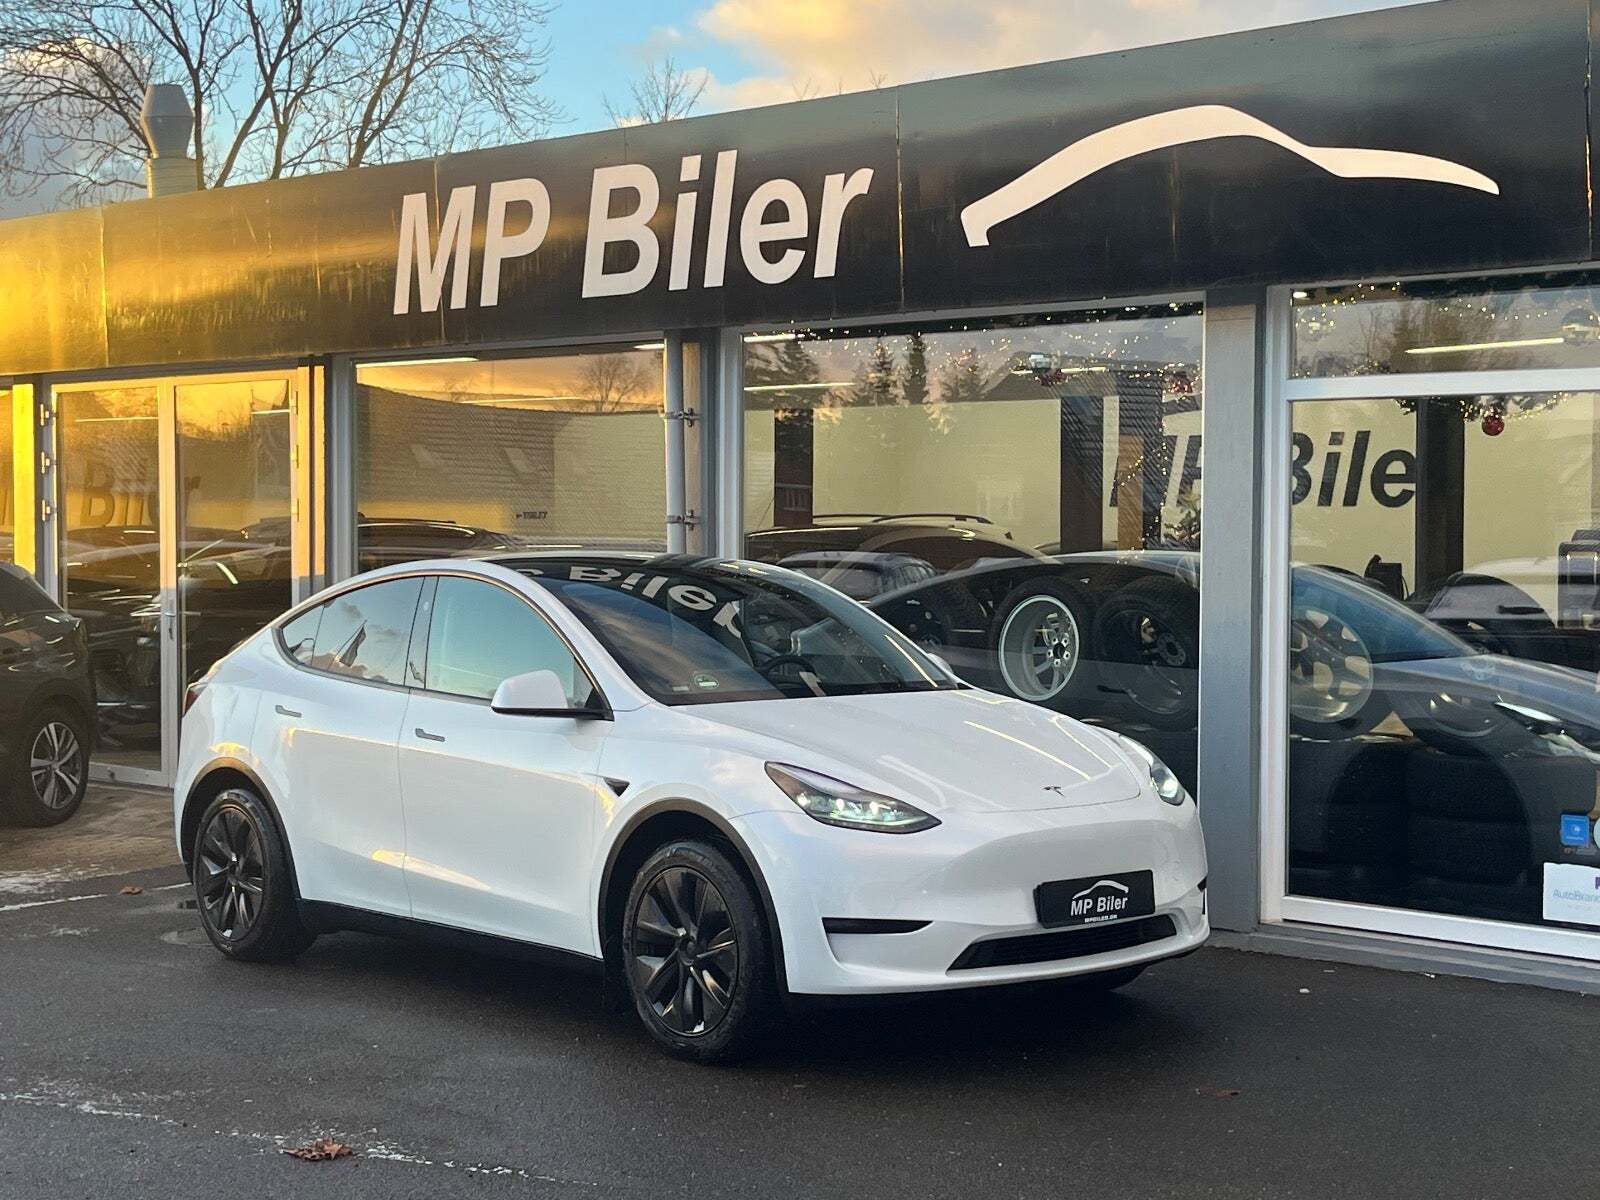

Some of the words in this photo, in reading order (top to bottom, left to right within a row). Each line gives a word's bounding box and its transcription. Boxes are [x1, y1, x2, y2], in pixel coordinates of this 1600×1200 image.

[393, 177, 552, 315] MP
[581, 149, 875, 298] Biler
[1070, 899, 1093, 916] MP
[1097, 896, 1128, 913] Biler
